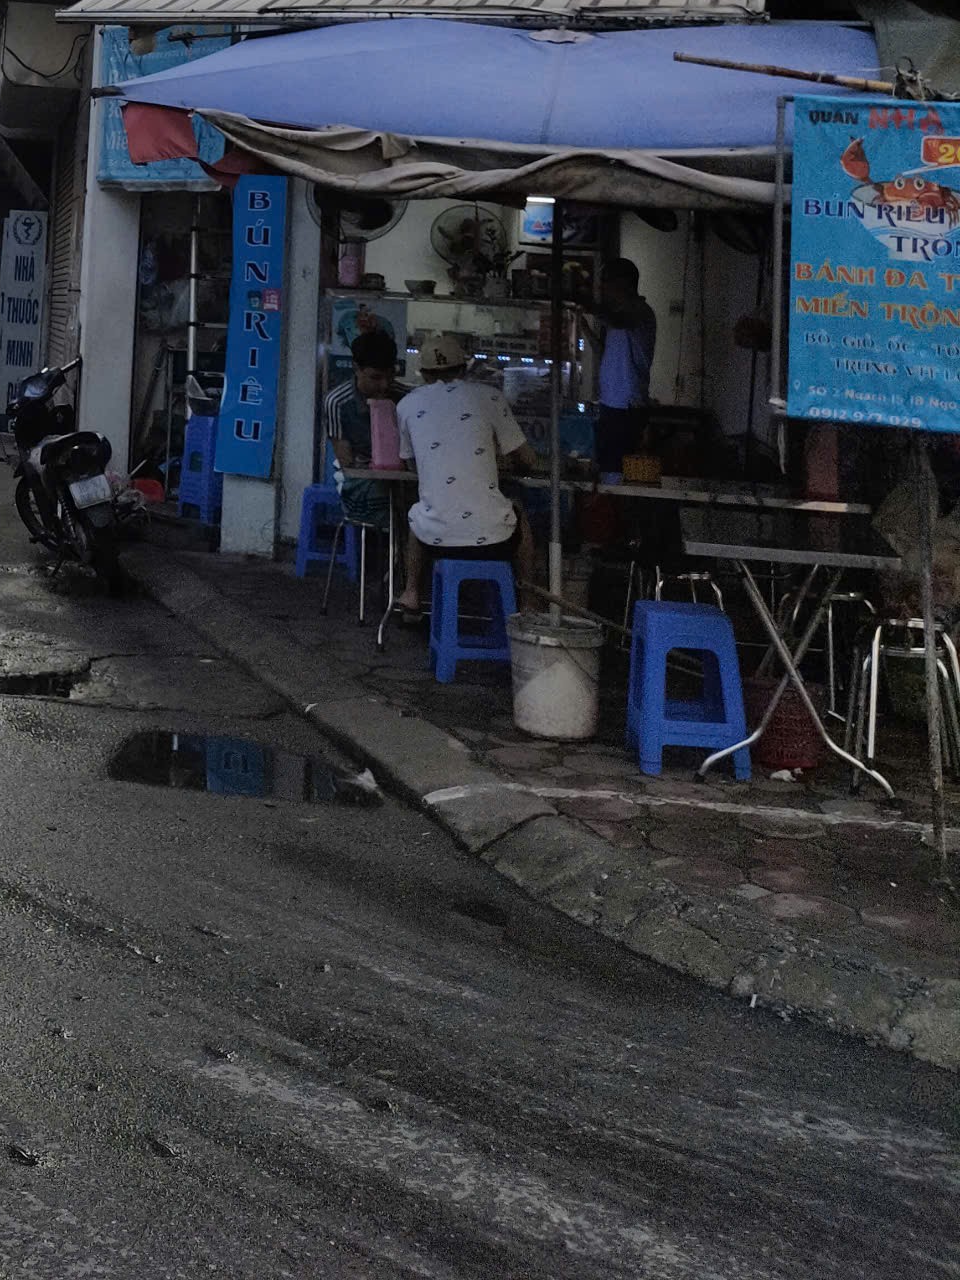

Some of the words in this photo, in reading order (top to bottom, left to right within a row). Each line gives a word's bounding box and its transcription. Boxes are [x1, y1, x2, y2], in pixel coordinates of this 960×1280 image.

[804, 193, 865, 219] BÚN
[876, 200, 945, 228] RIÊU
[244, 190, 272, 284] BÚN
[14, 251, 35, 282] NHÀ
[795, 258, 876, 286] BÁNH
[885, 268, 928, 290] ĐA
[7, 288, 39, 325] THUỐC
[796, 291, 869, 318] MIẾN
[6, 339, 34, 368] MINH
[233, 310, 272, 442] RIÊU
